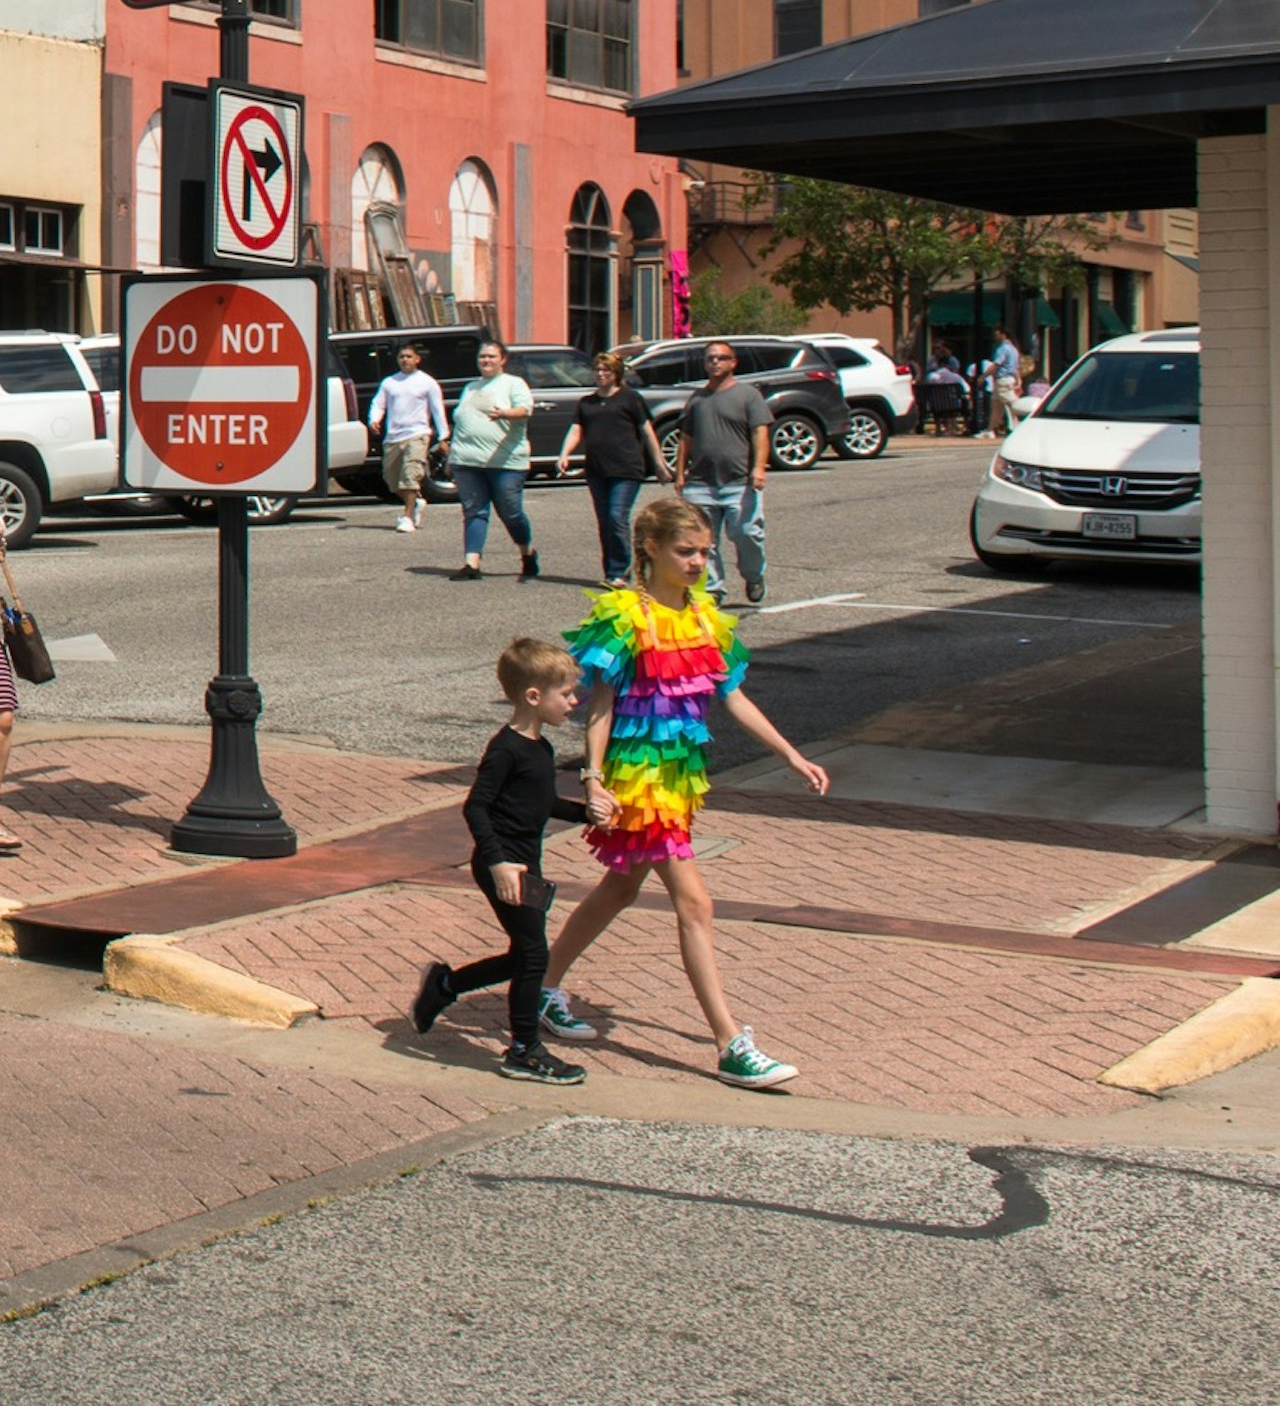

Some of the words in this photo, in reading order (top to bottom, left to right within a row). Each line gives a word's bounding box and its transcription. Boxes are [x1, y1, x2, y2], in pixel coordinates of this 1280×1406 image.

[157, 324, 197, 355] DO
[221, 322, 284, 354] NOT
[168, 414, 268, 445] ENTER
